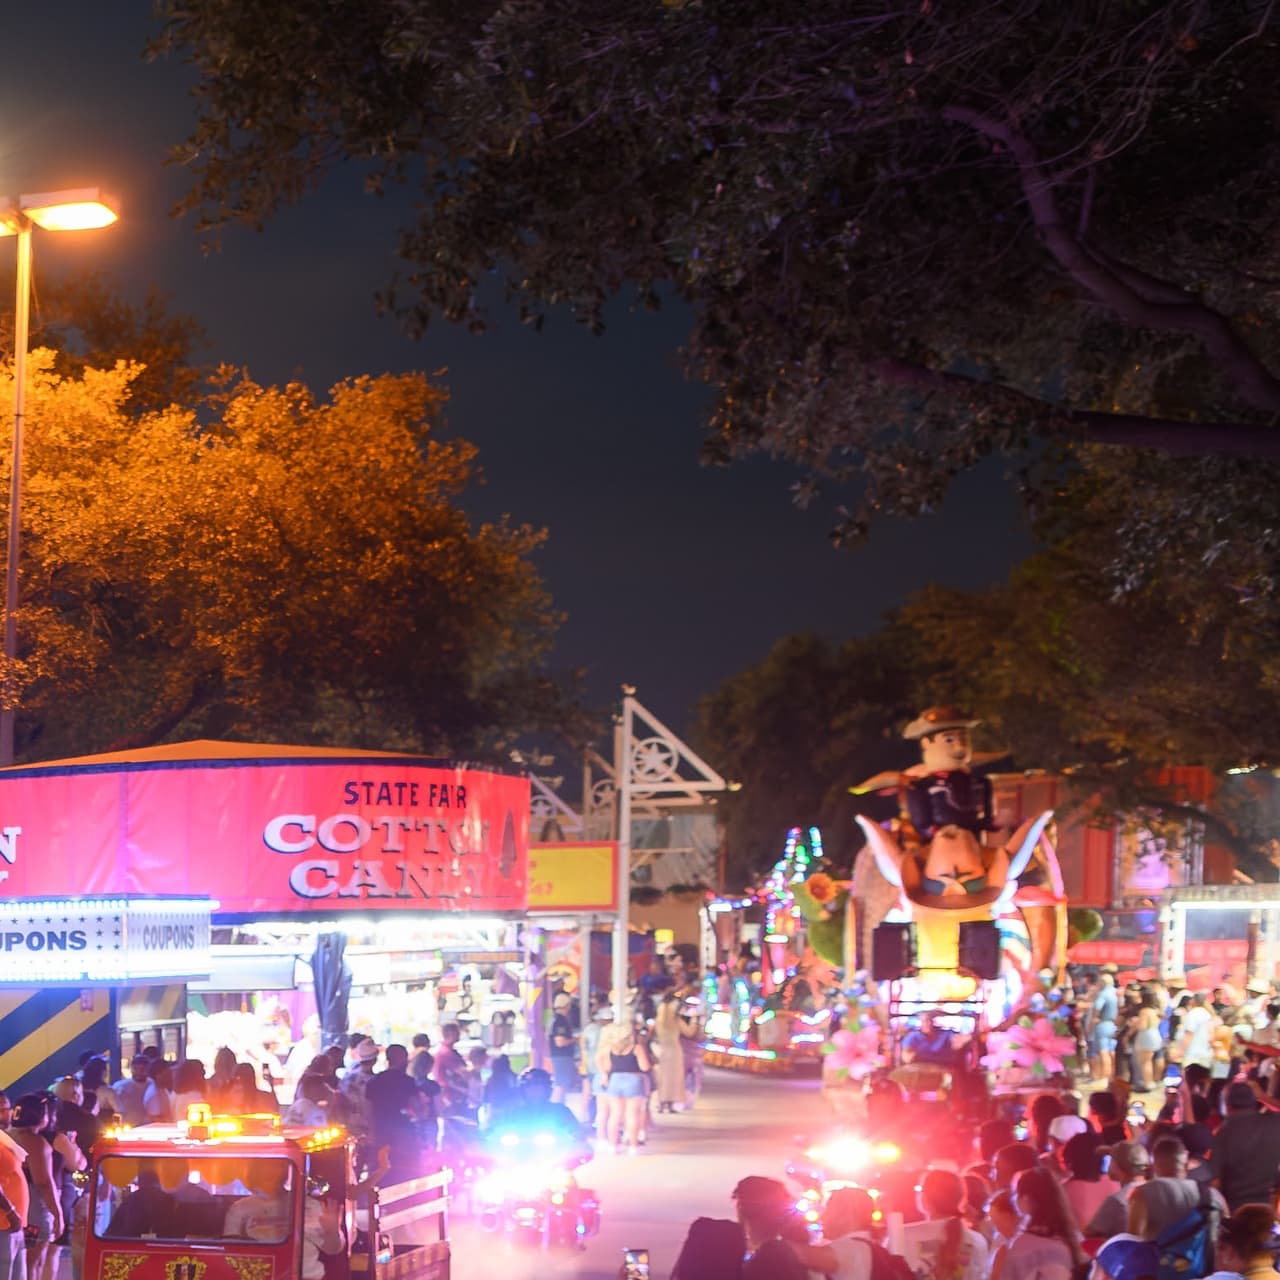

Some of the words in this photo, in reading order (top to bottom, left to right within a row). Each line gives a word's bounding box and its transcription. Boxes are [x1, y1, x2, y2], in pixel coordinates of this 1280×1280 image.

[343, 780, 419, 806] STATE
[428, 784, 467, 808] FAIR
[143, 923, 196, 951] COUPONS
